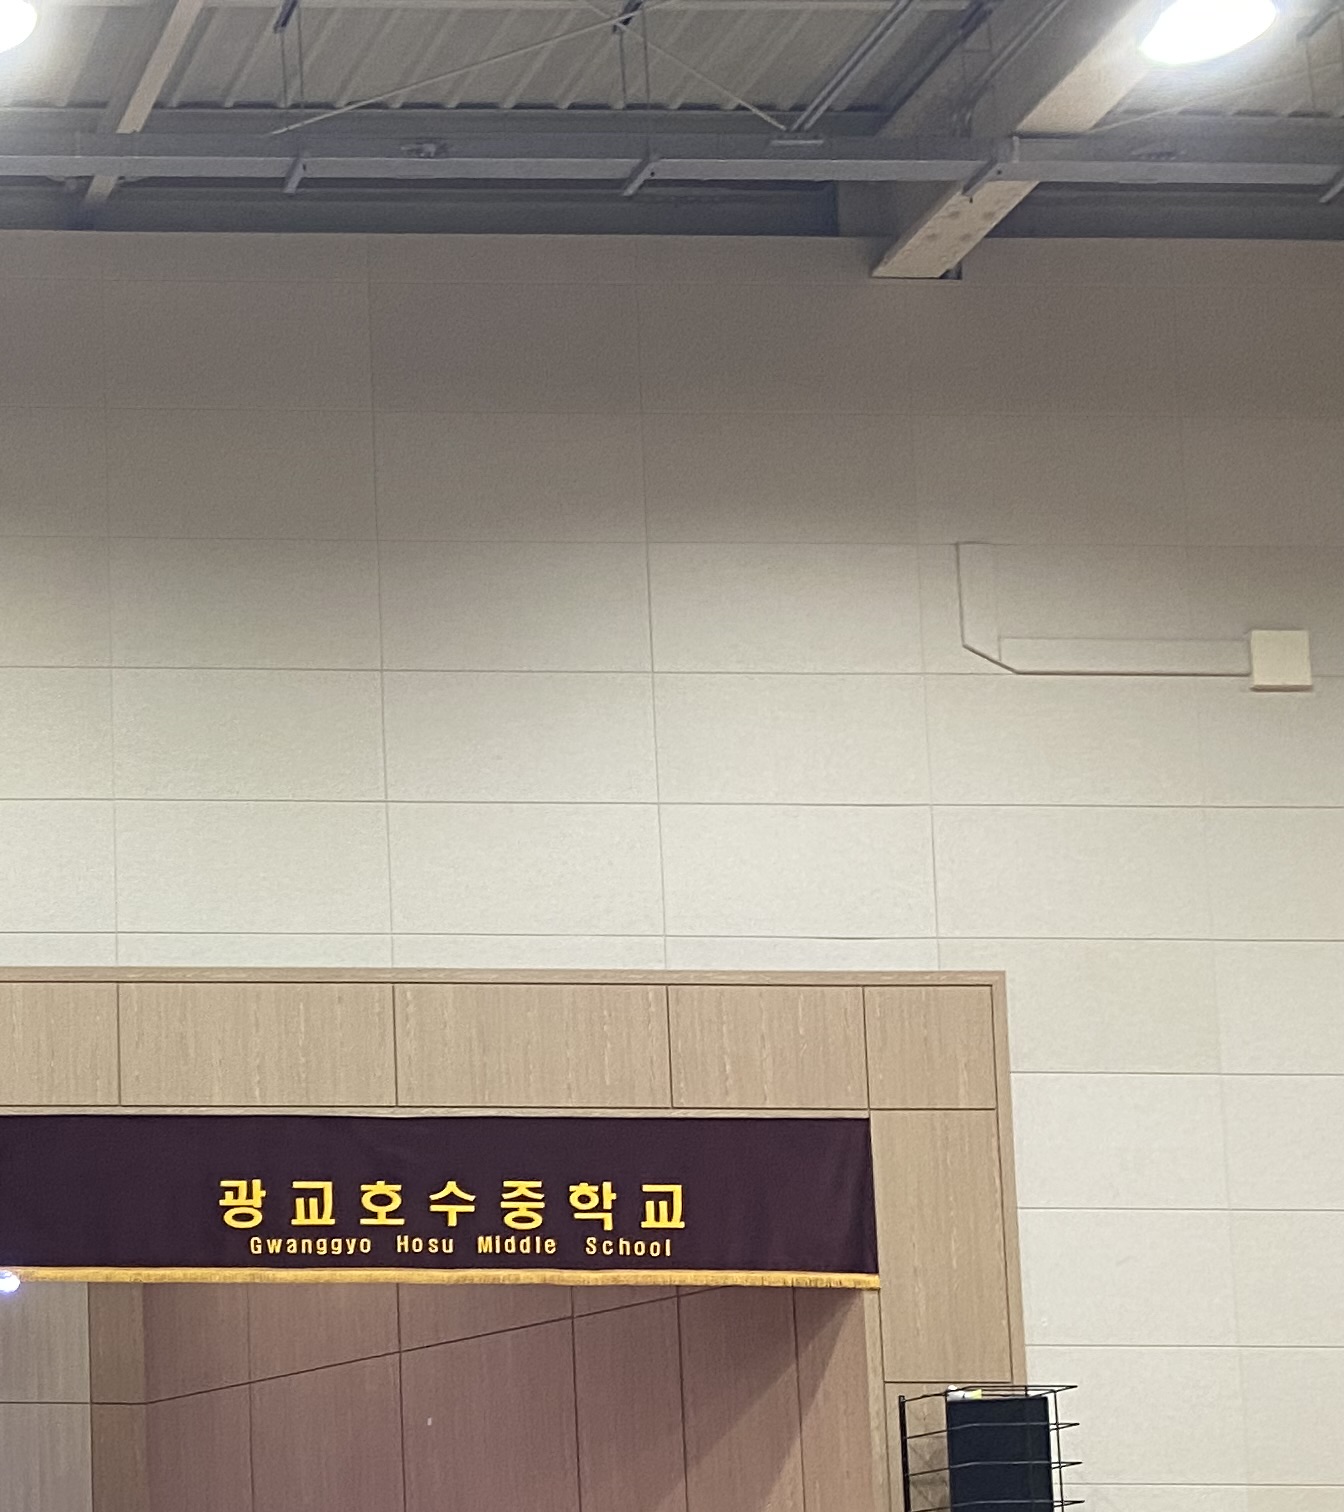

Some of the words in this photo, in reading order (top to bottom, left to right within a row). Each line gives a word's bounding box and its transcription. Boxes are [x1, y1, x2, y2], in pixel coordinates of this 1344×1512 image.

[218, 1178, 686, 1231] 광교호수중학교
[249, 1235, 372, 1255] Gwanggyo
[396, 1234, 455, 1254] Hosu
[477, 1235, 557, 1255] Middle
[585, 1236, 671, 1257] School
